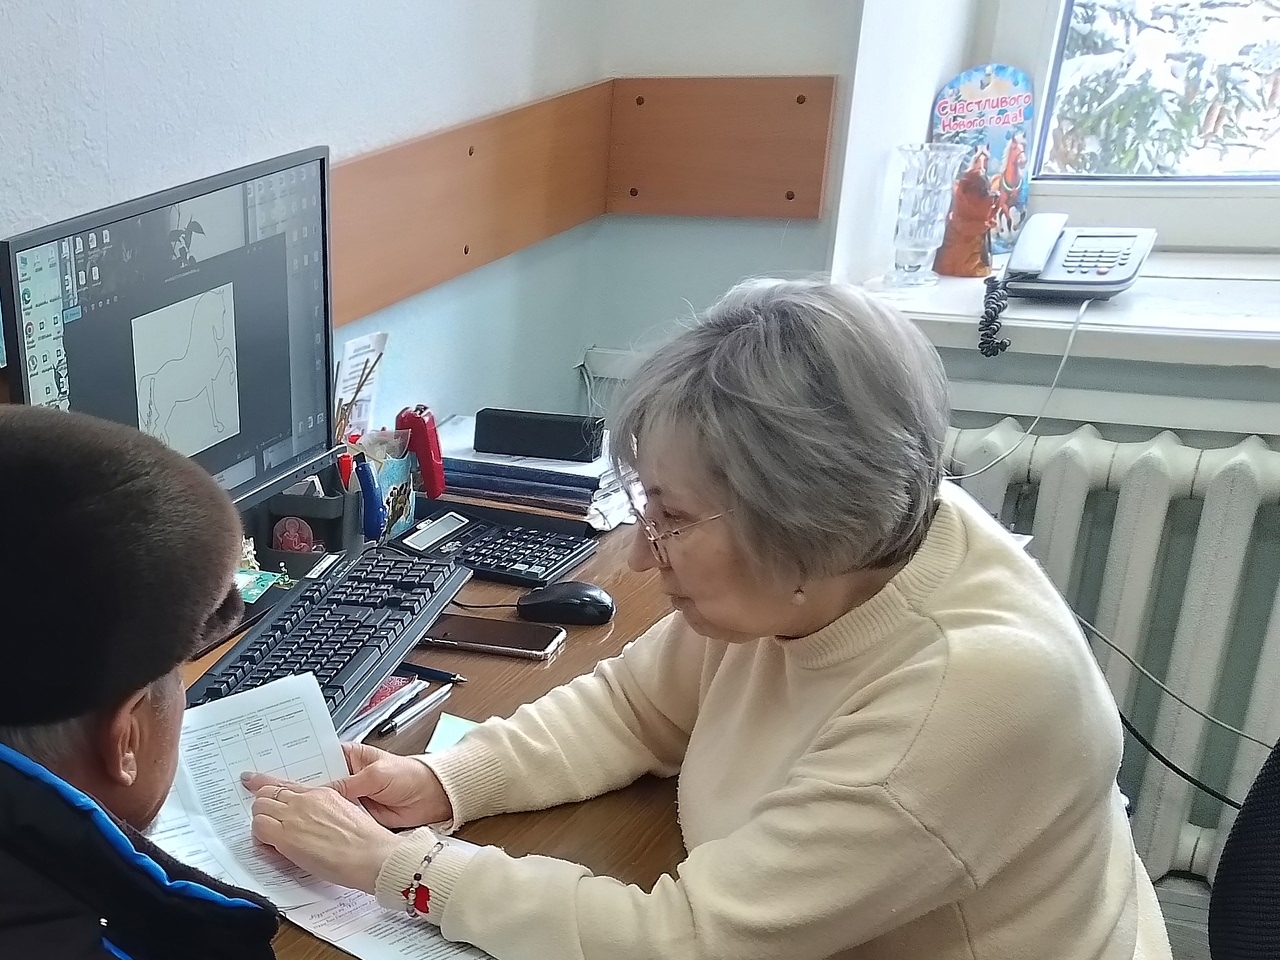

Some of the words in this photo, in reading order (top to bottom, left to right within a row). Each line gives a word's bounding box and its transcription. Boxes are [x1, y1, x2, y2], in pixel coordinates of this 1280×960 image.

[937, 94, 1031, 116] Счастливого
[942, 118, 985, 132] Нового
[989, 108, 1023, 126] года!
